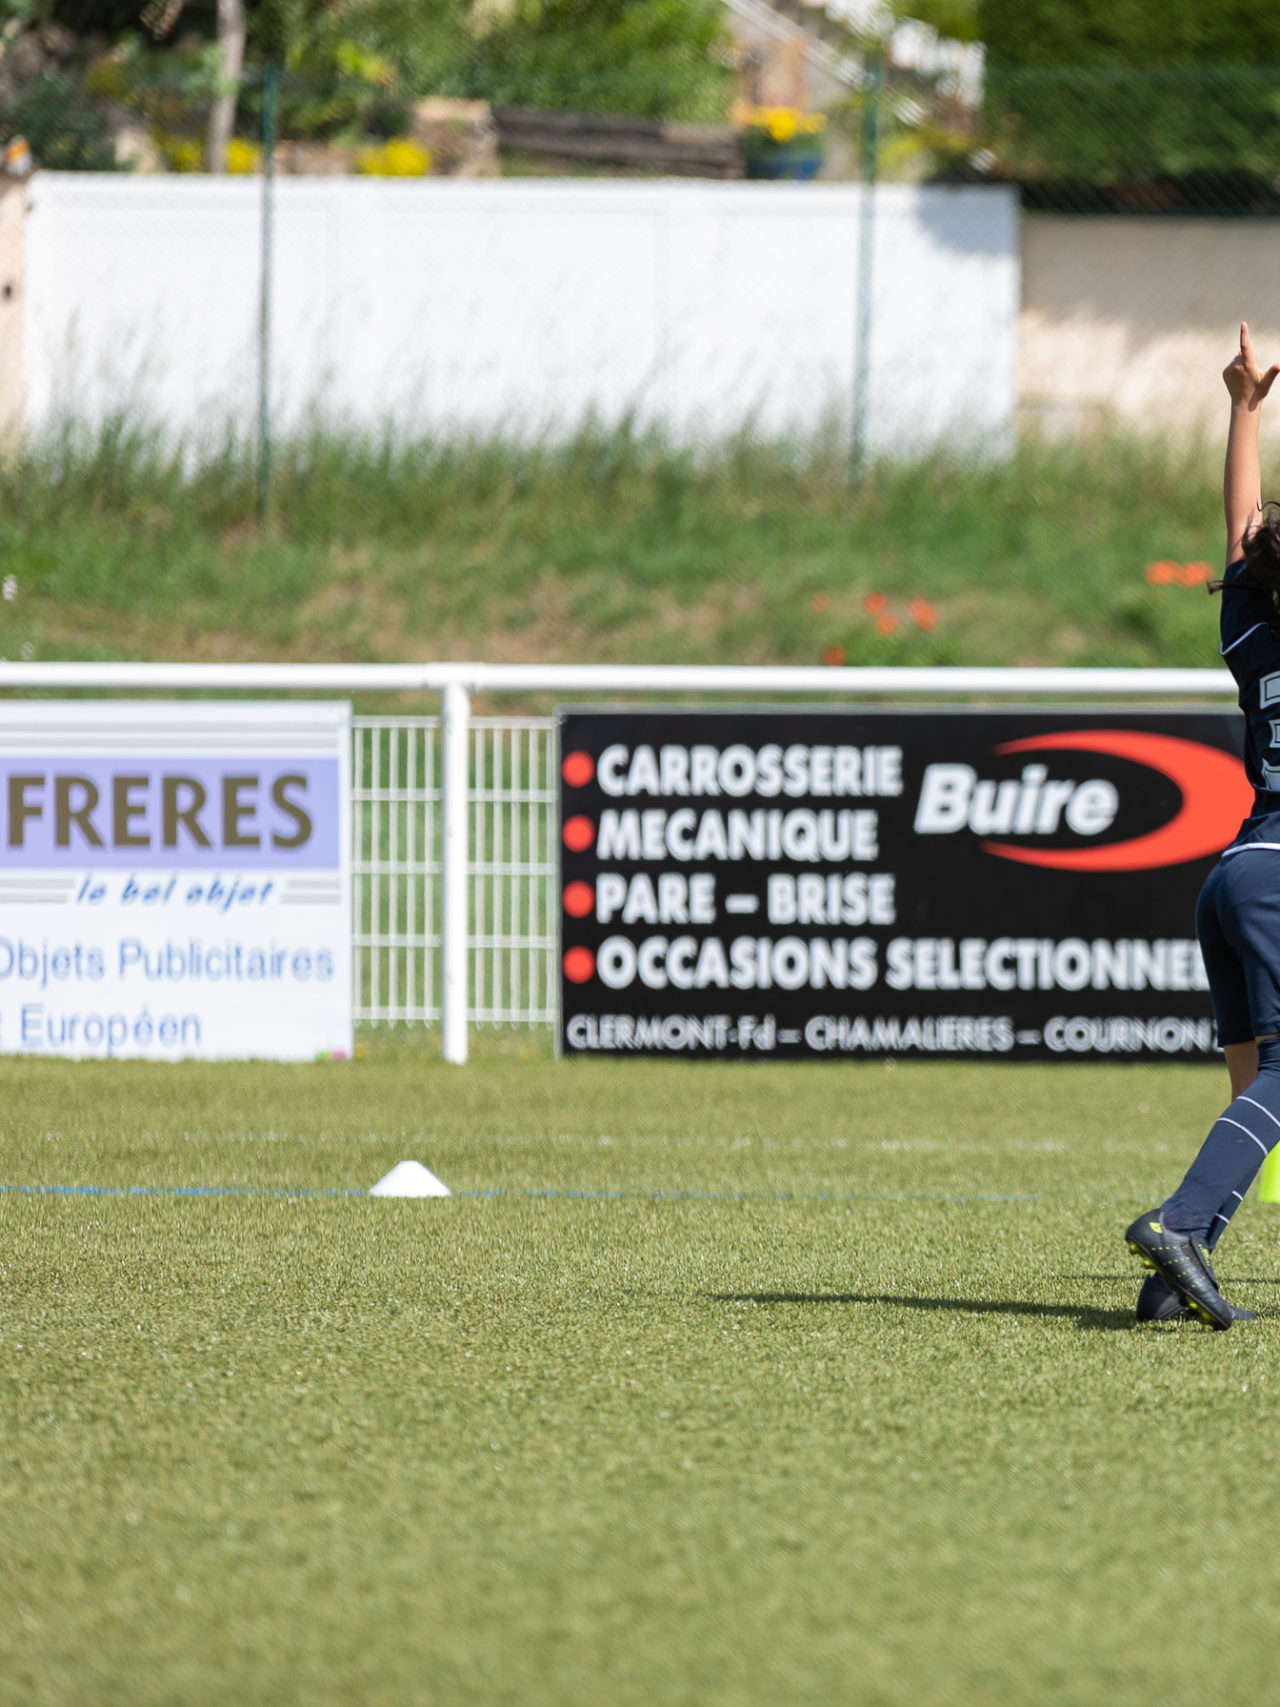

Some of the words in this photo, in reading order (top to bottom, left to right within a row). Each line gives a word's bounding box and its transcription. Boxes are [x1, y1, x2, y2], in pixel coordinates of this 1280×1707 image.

[597, 744, 903, 797] CARROSSERIE
[7, 773, 313, 849] FRERES
[915, 763, 1118, 835] Buire
[597, 808, 879, 863] MECANIQUE
[77, 872, 108, 903] le
[121, 872, 178, 904] bel
[186, 873, 274, 914] objet
[596, 872, 717, 925] PARE
[767, 872, 896, 926] BRISE
[118, 937, 335, 982] Publicitaires
[597, 935, 878, 991] OCCASIONS
[20, 1002, 202, 1056] Européen
[804, 1015, 1014, 1051] CHAMALIERES
